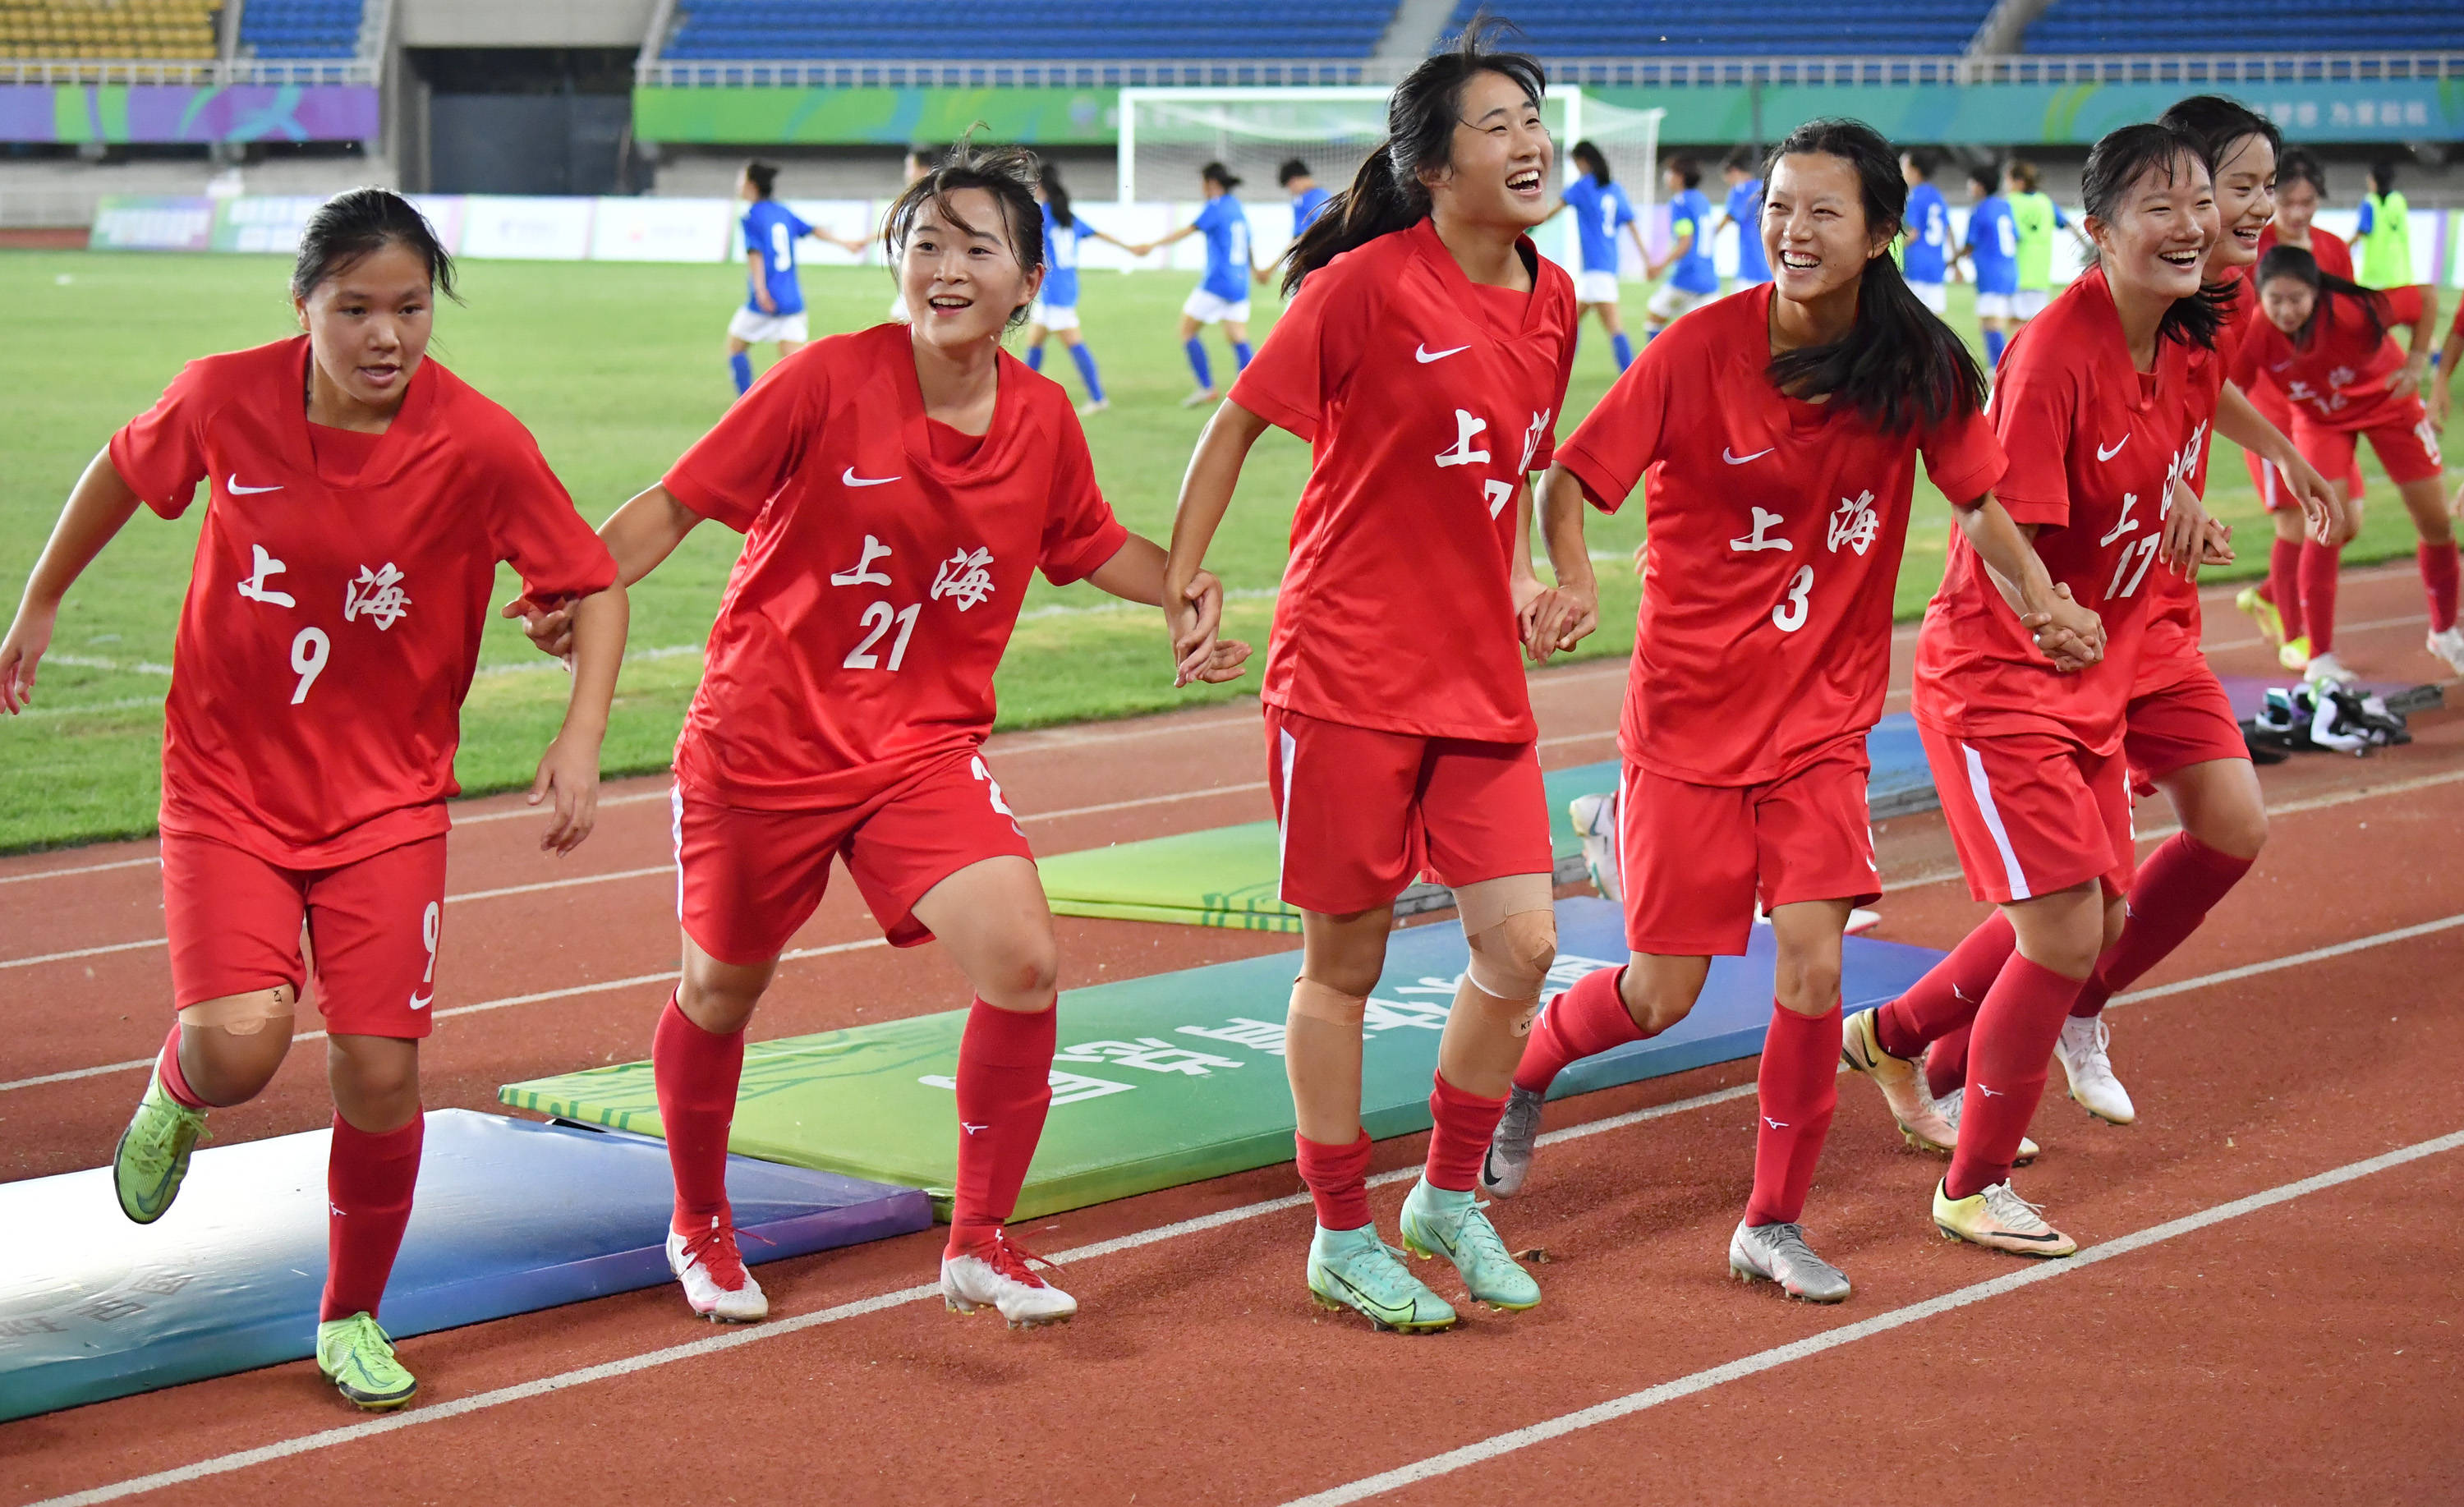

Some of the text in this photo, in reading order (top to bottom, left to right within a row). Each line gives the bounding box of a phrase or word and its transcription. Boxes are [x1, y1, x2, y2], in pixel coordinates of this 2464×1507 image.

[771, 222, 791, 273] 9
[1924, 202, 1944, 247] 5
[1730, 489, 1879, 557] 上海
[237, 543, 412, 632] 上海
[830, 534, 995, 613] 上海
[1772, 564, 1814, 632] 3
[2103, 531, 2161, 601] 17
[291, 626, 331, 705] 9
[843, 600, 922, 672] 21
[423, 900, 440, 984] 9
